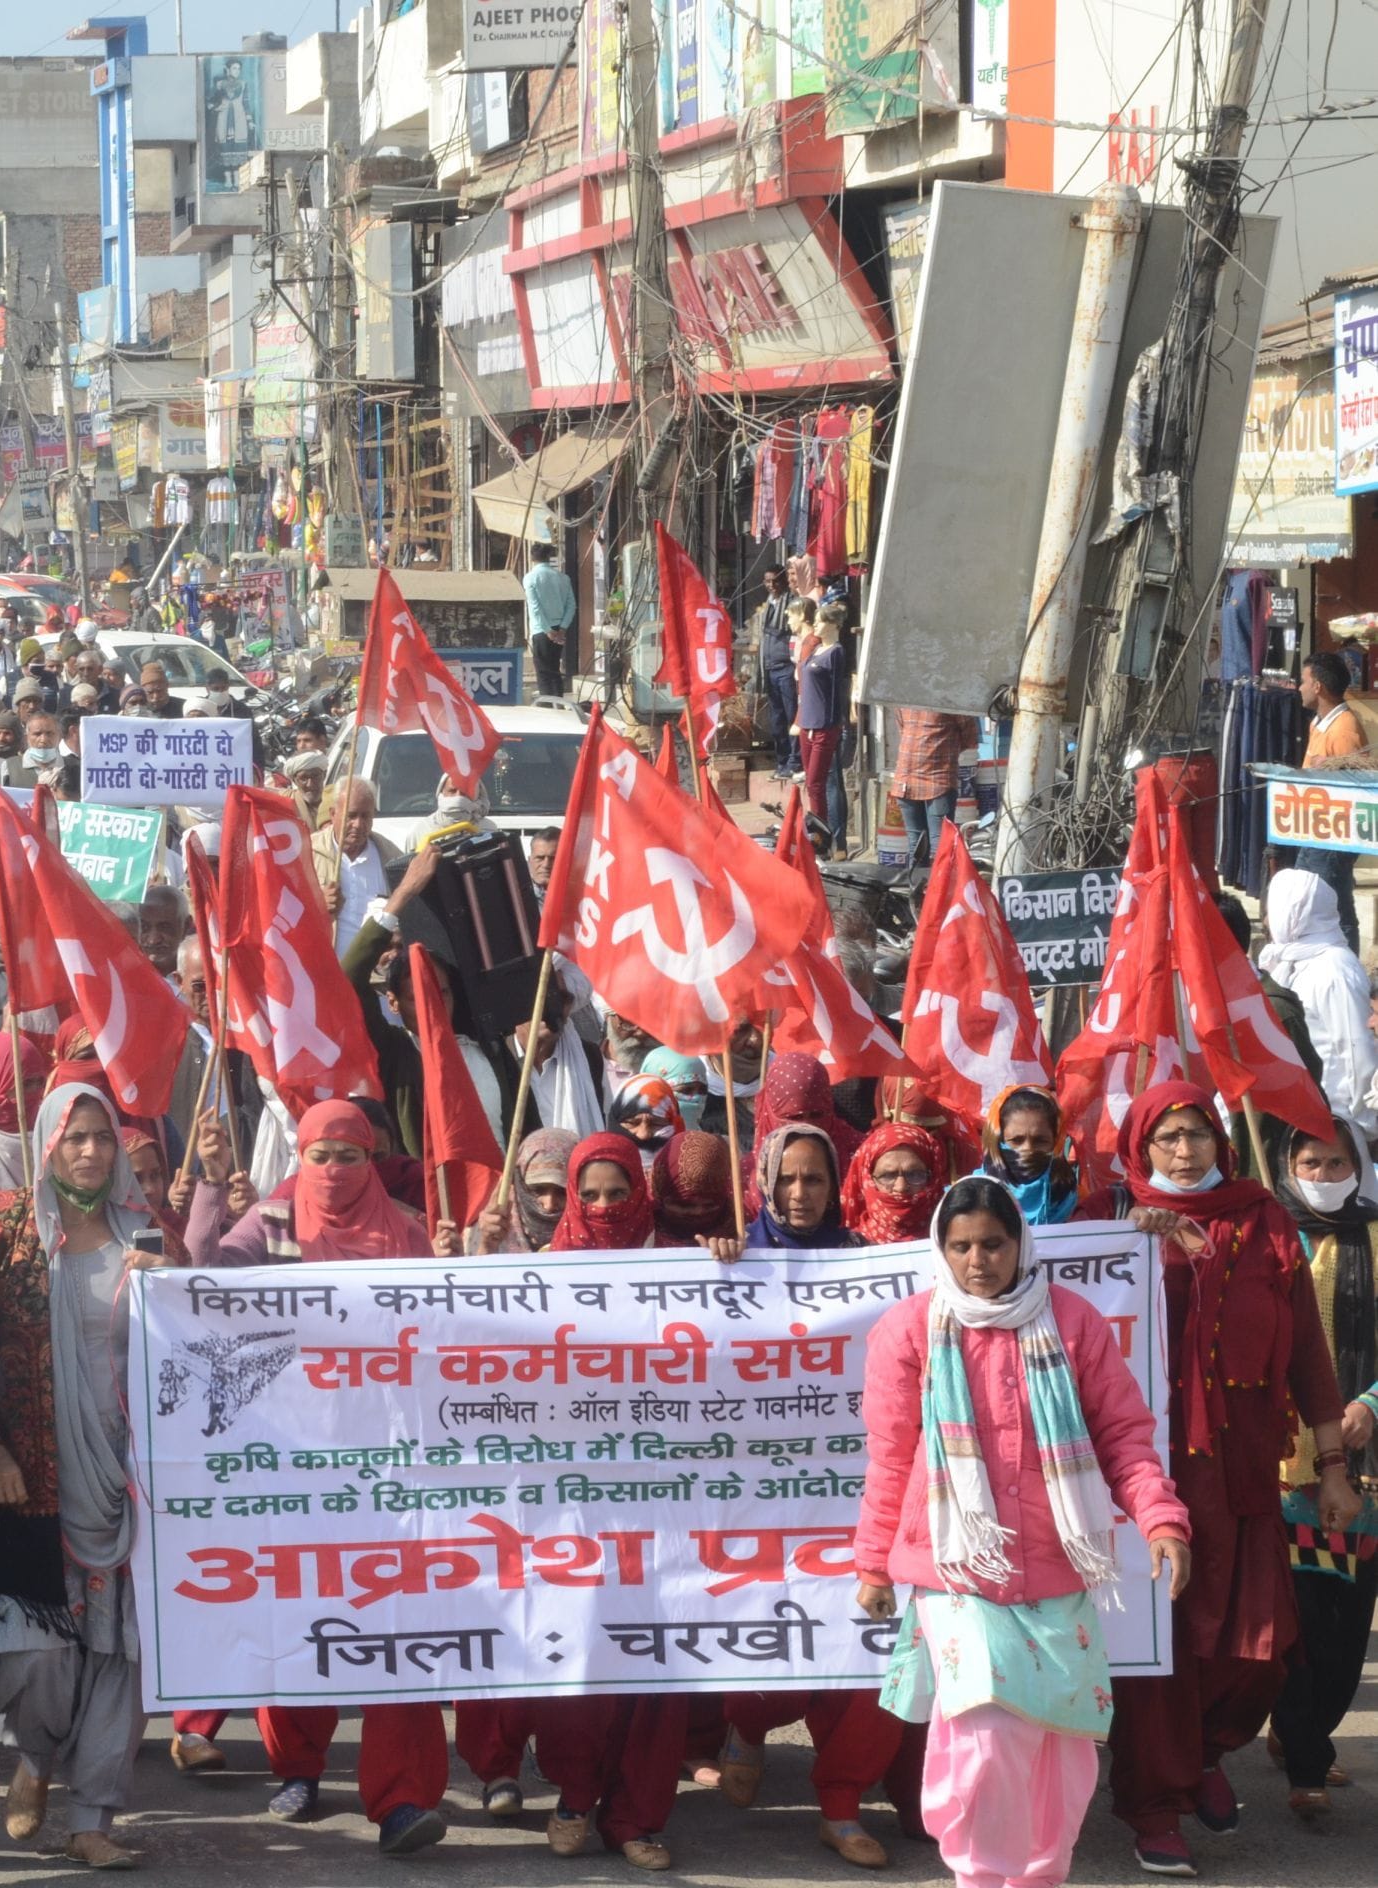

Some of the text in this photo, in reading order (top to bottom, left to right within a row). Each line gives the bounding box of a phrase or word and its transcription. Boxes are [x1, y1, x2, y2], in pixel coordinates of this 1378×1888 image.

[473, 8, 523, 27] AJEET
[1108, 105, 1158, 183] RAJ
[99, 728, 234, 756] MSP की गारंटी दो
[87, 761, 133, 789] गारंटी
[1274, 783, 1352, 840] रोहित
[1003, 872, 1121, 922] किसान विरो
[184, 1275, 348, 1322] किसान,
[368, 1271, 554, 1316] कर्मचारी
[569, 1282, 612, 1312] व
[628, 1278, 767, 1320] मजदूर
[782, 1269, 920, 1313] एकता
[300, 1321, 851, 1390] सर्व कर्मचारी संघ
[568, 1390, 620, 1423] ऑल
[629, 1389, 691, 1424] इंडिया
[700, 1389, 747, 1424] स्टेट
[755, 1384, 838, 1420] गवर्नमेंट
[204, 1442, 281, 1483] कृषि
[290, 1438, 420, 1480] कानूनों
[424, 1437, 465, 1467] के
[474, 1433, 576, 1467] विरोध
[586, 1432, 626, 1461] में
[630, 1431, 737, 1462] दिल्ली
[747, 1436, 819, 1467] कूच
[164, 1467, 867, 1519] पर दमन के खिलाफ व किसानों के आंदोल
[173, 1512, 656, 1611] आक्रोश
[303, 1617, 506, 1679] जिला
[600, 1599, 827, 1666] चरखी
